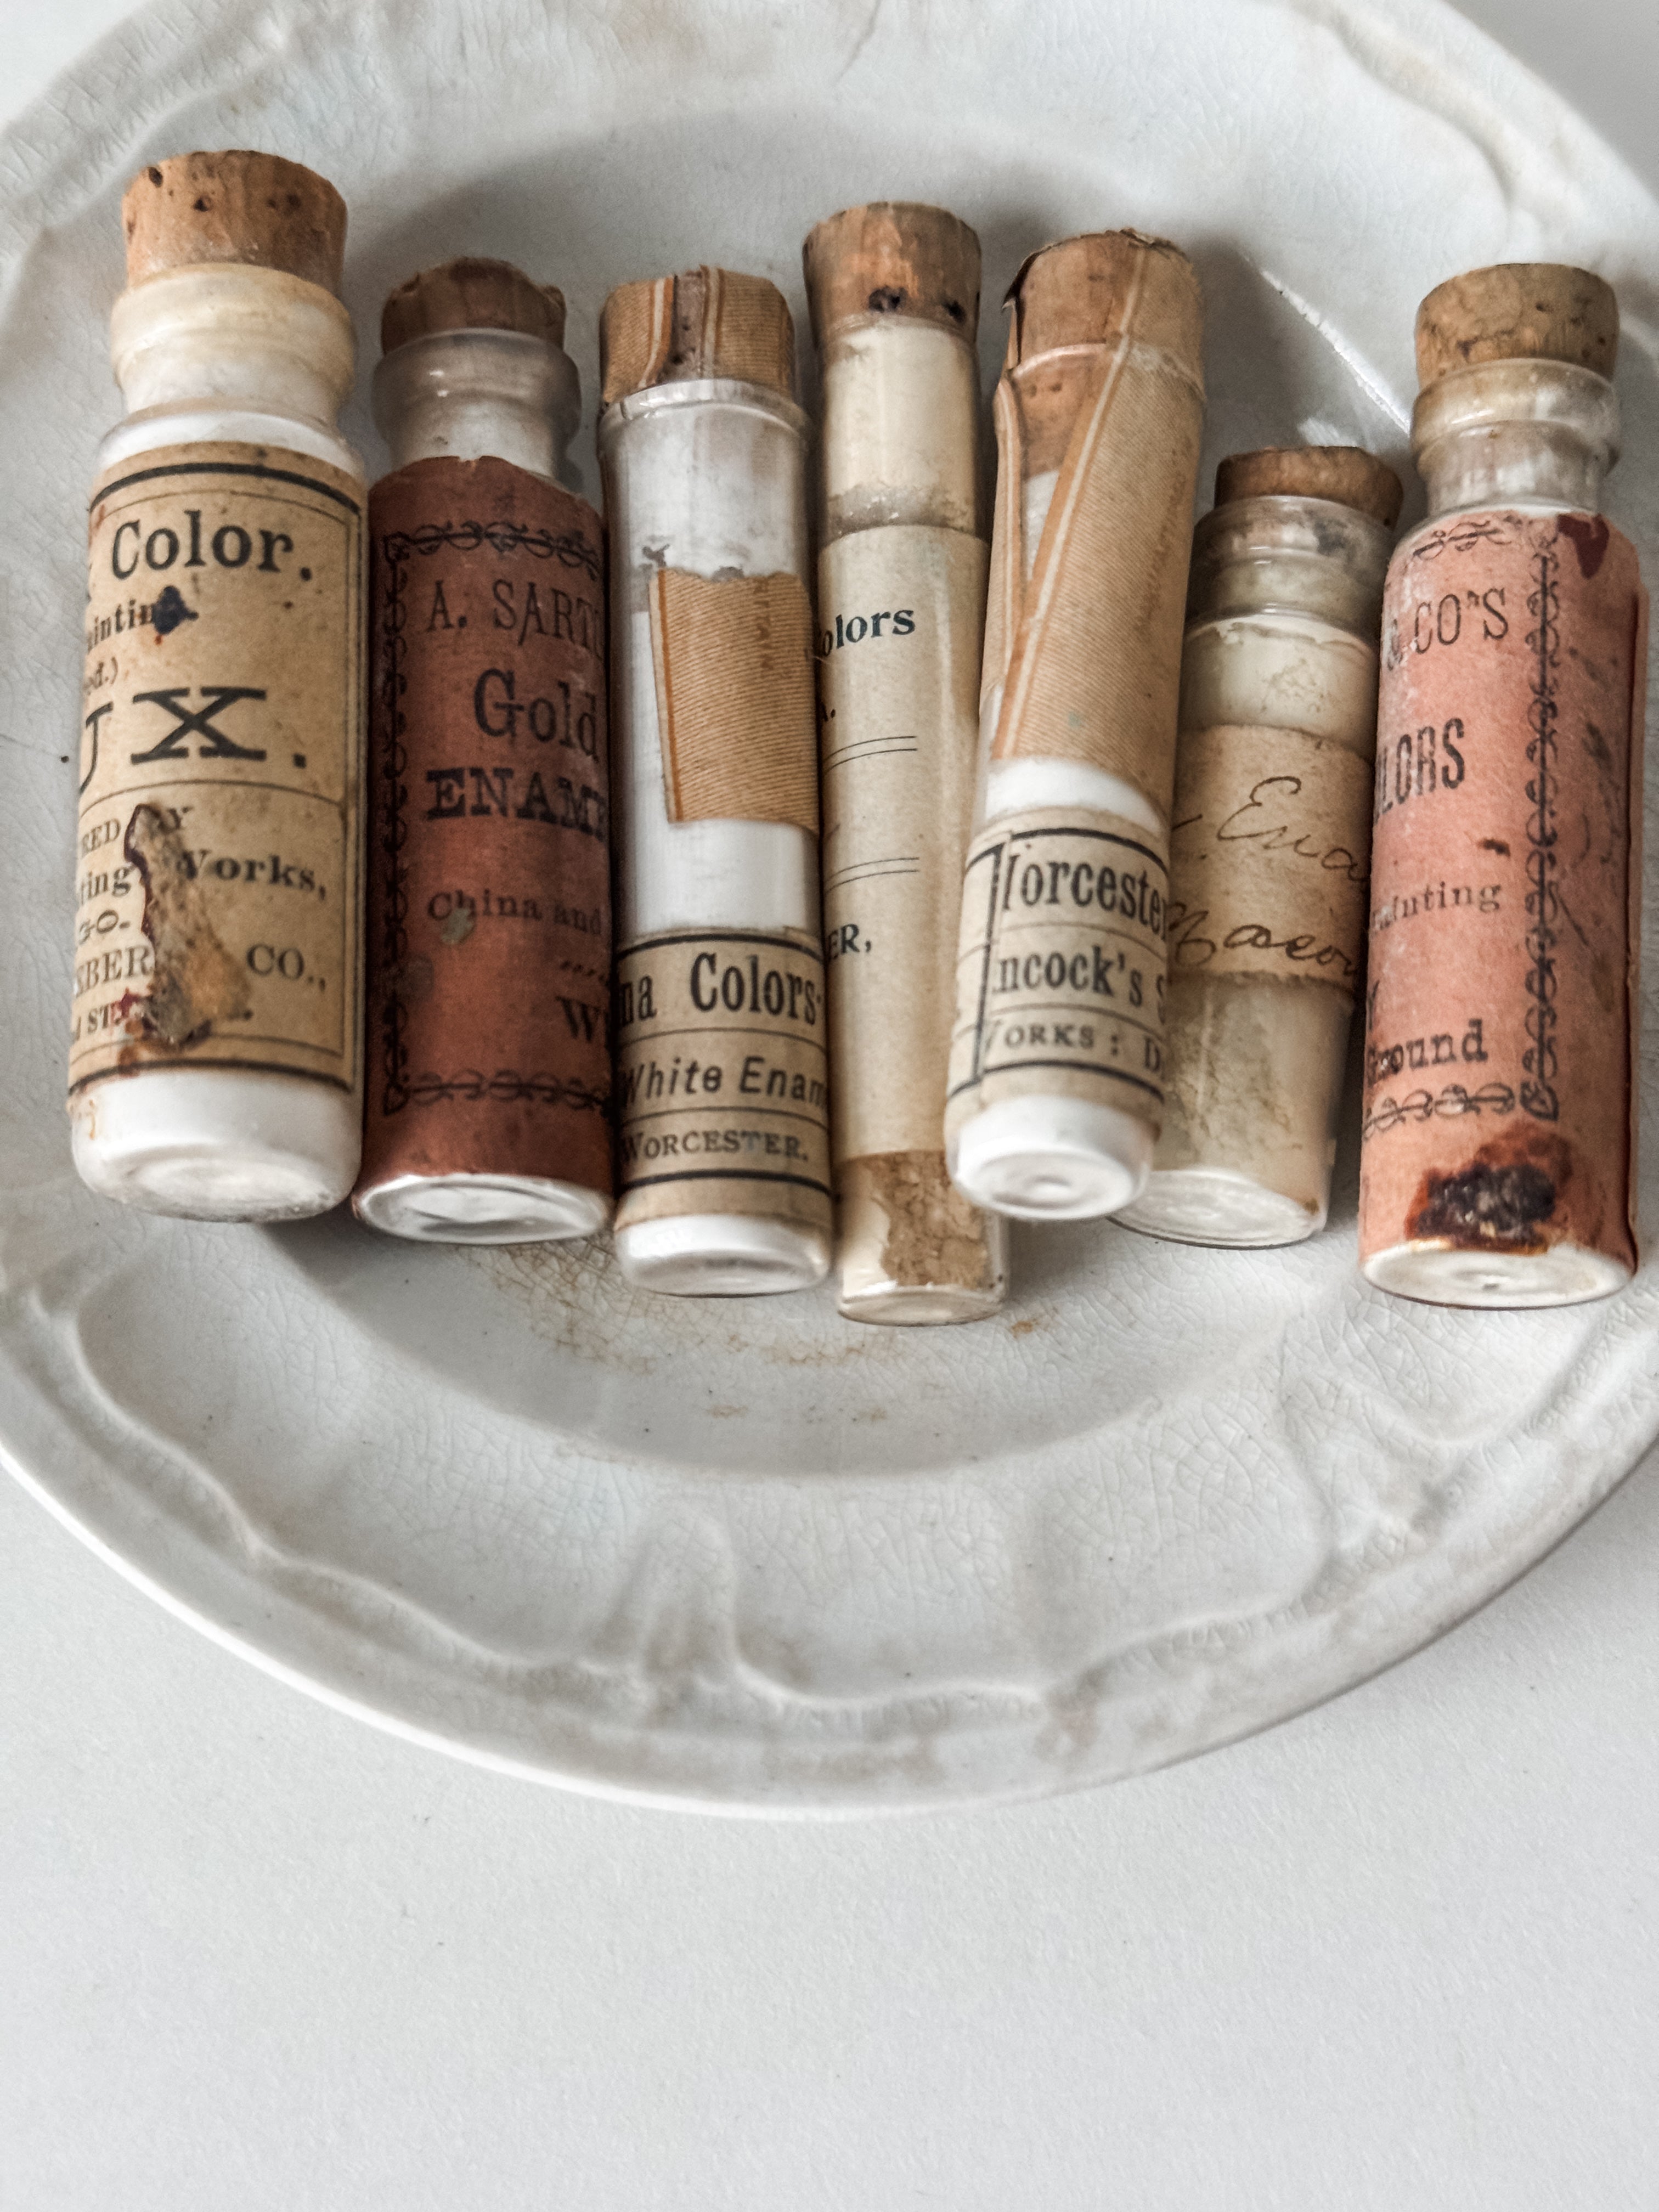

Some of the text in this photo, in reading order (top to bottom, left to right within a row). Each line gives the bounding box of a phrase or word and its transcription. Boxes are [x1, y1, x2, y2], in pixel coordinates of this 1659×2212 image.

[111, 509, 313, 582] Color.
[426, 579, 468, 633] A.
[473, 668, 599, 764] Gold
[427, 888, 602, 935] China and
[246, 942, 326, 991] CO.,
